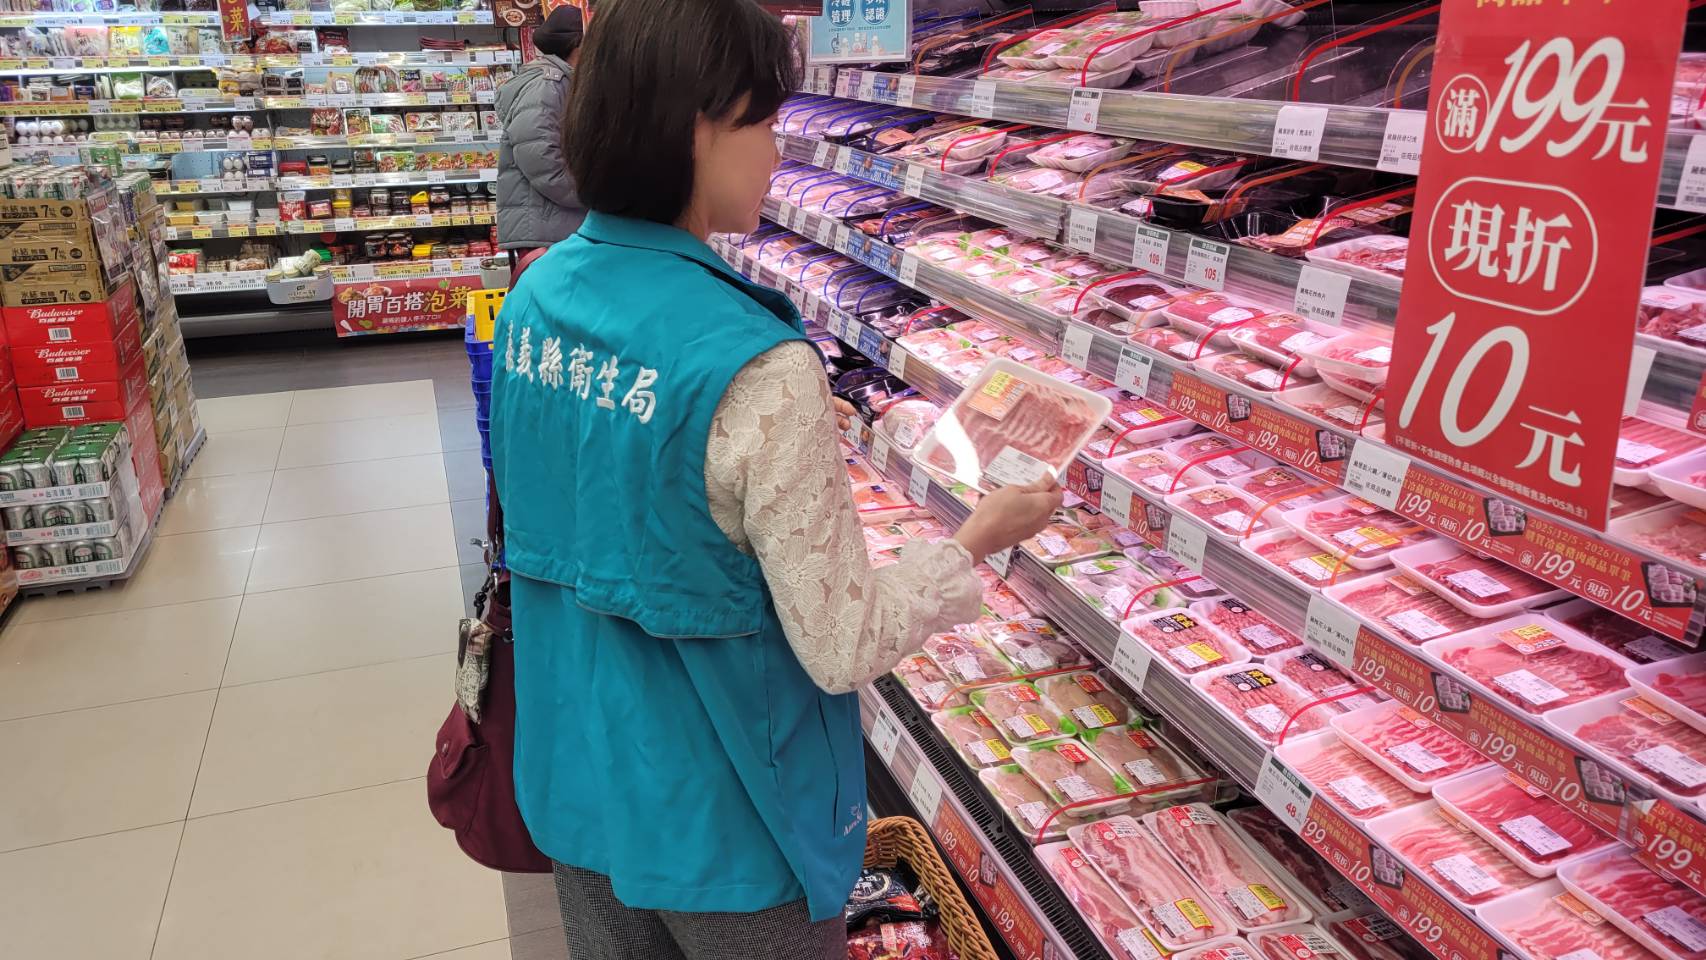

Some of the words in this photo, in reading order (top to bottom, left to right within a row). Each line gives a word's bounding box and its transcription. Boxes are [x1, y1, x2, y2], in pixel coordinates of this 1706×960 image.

[831, 10, 851, 22] 管理
[864, 8, 885, 21] 認證
[1445, 200, 1573, 291] 現折
[1204, 267, 1217, 280] 105
[27, 309, 83, 319] Budweiser
[36, 348, 91, 359] Budweiser
[41, 388, 96, 399] Budweiser
[1440, 517, 1458, 531] 現折
[1586, 583, 1609, 600] 現折
[1529, 769, 1549, 788] 現折
[1286, 803, 1297, 818] 48
